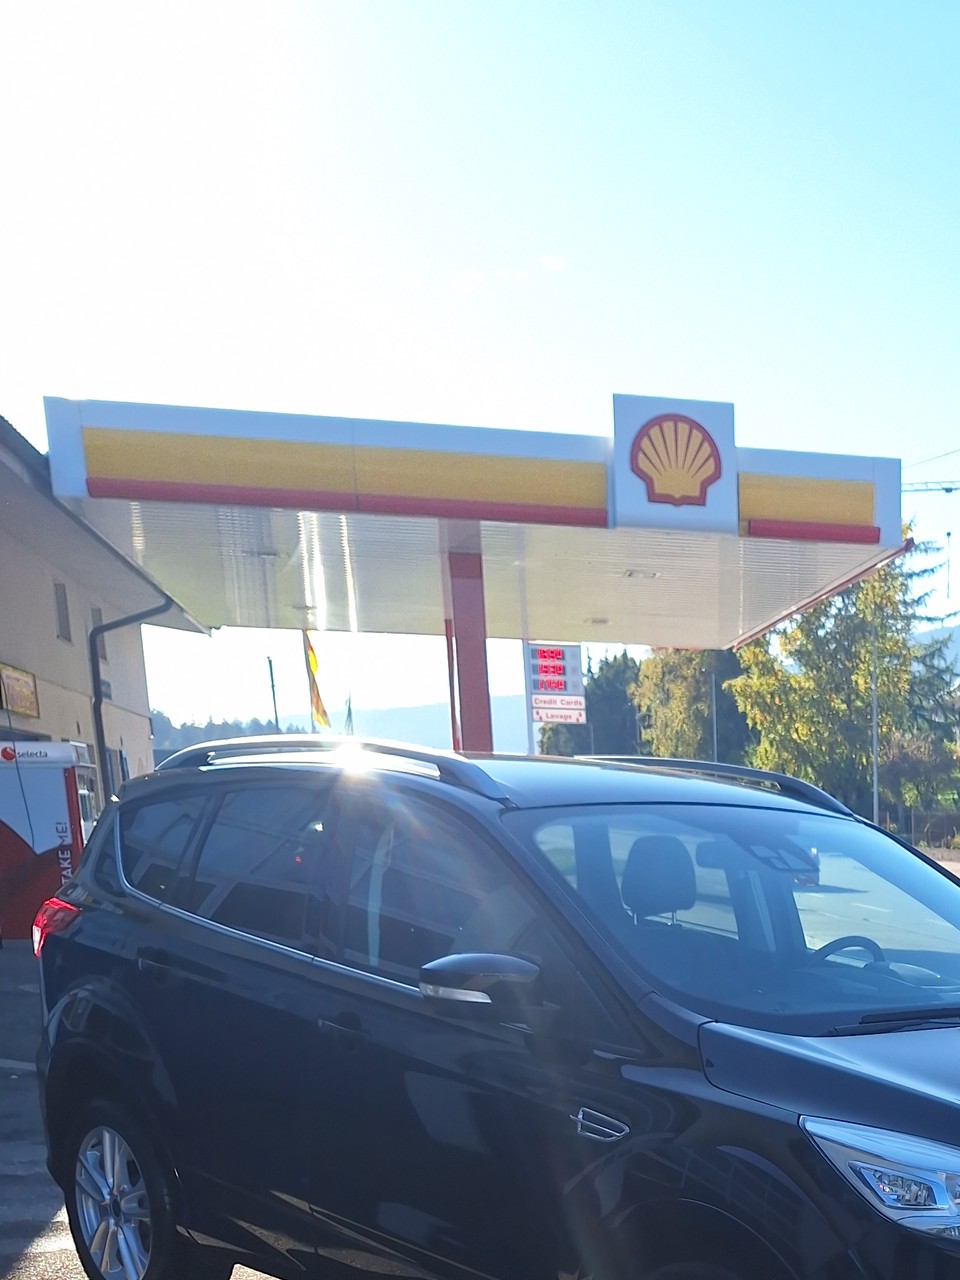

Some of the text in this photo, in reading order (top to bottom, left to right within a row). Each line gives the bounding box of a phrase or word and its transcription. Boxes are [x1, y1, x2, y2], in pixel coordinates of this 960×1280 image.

[534, 697, 583, 707] Credit Cards
[545, 712, 572, 721] Lavage
[17, 750, 48, 759] selecta
